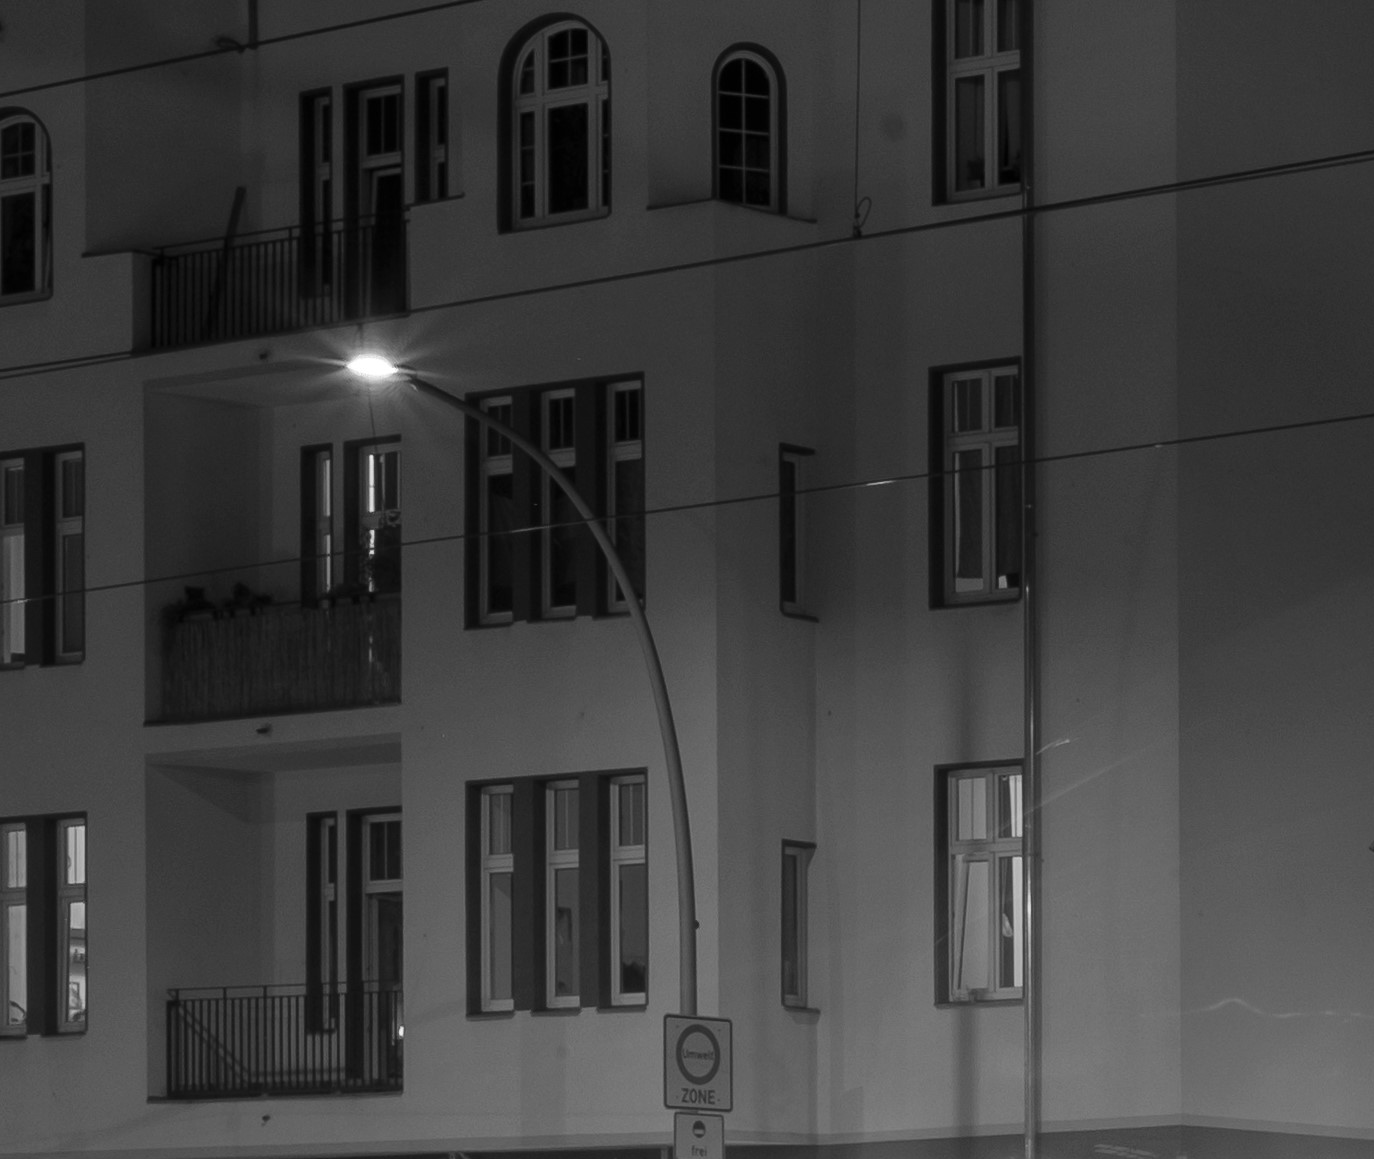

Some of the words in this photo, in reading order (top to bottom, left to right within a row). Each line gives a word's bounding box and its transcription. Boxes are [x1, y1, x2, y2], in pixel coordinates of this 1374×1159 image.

[682, 1048, 714, 1060] Umwelt
[681, 1087, 716, 1105] ZONE
[691, 1145, 708, 1157] frei
